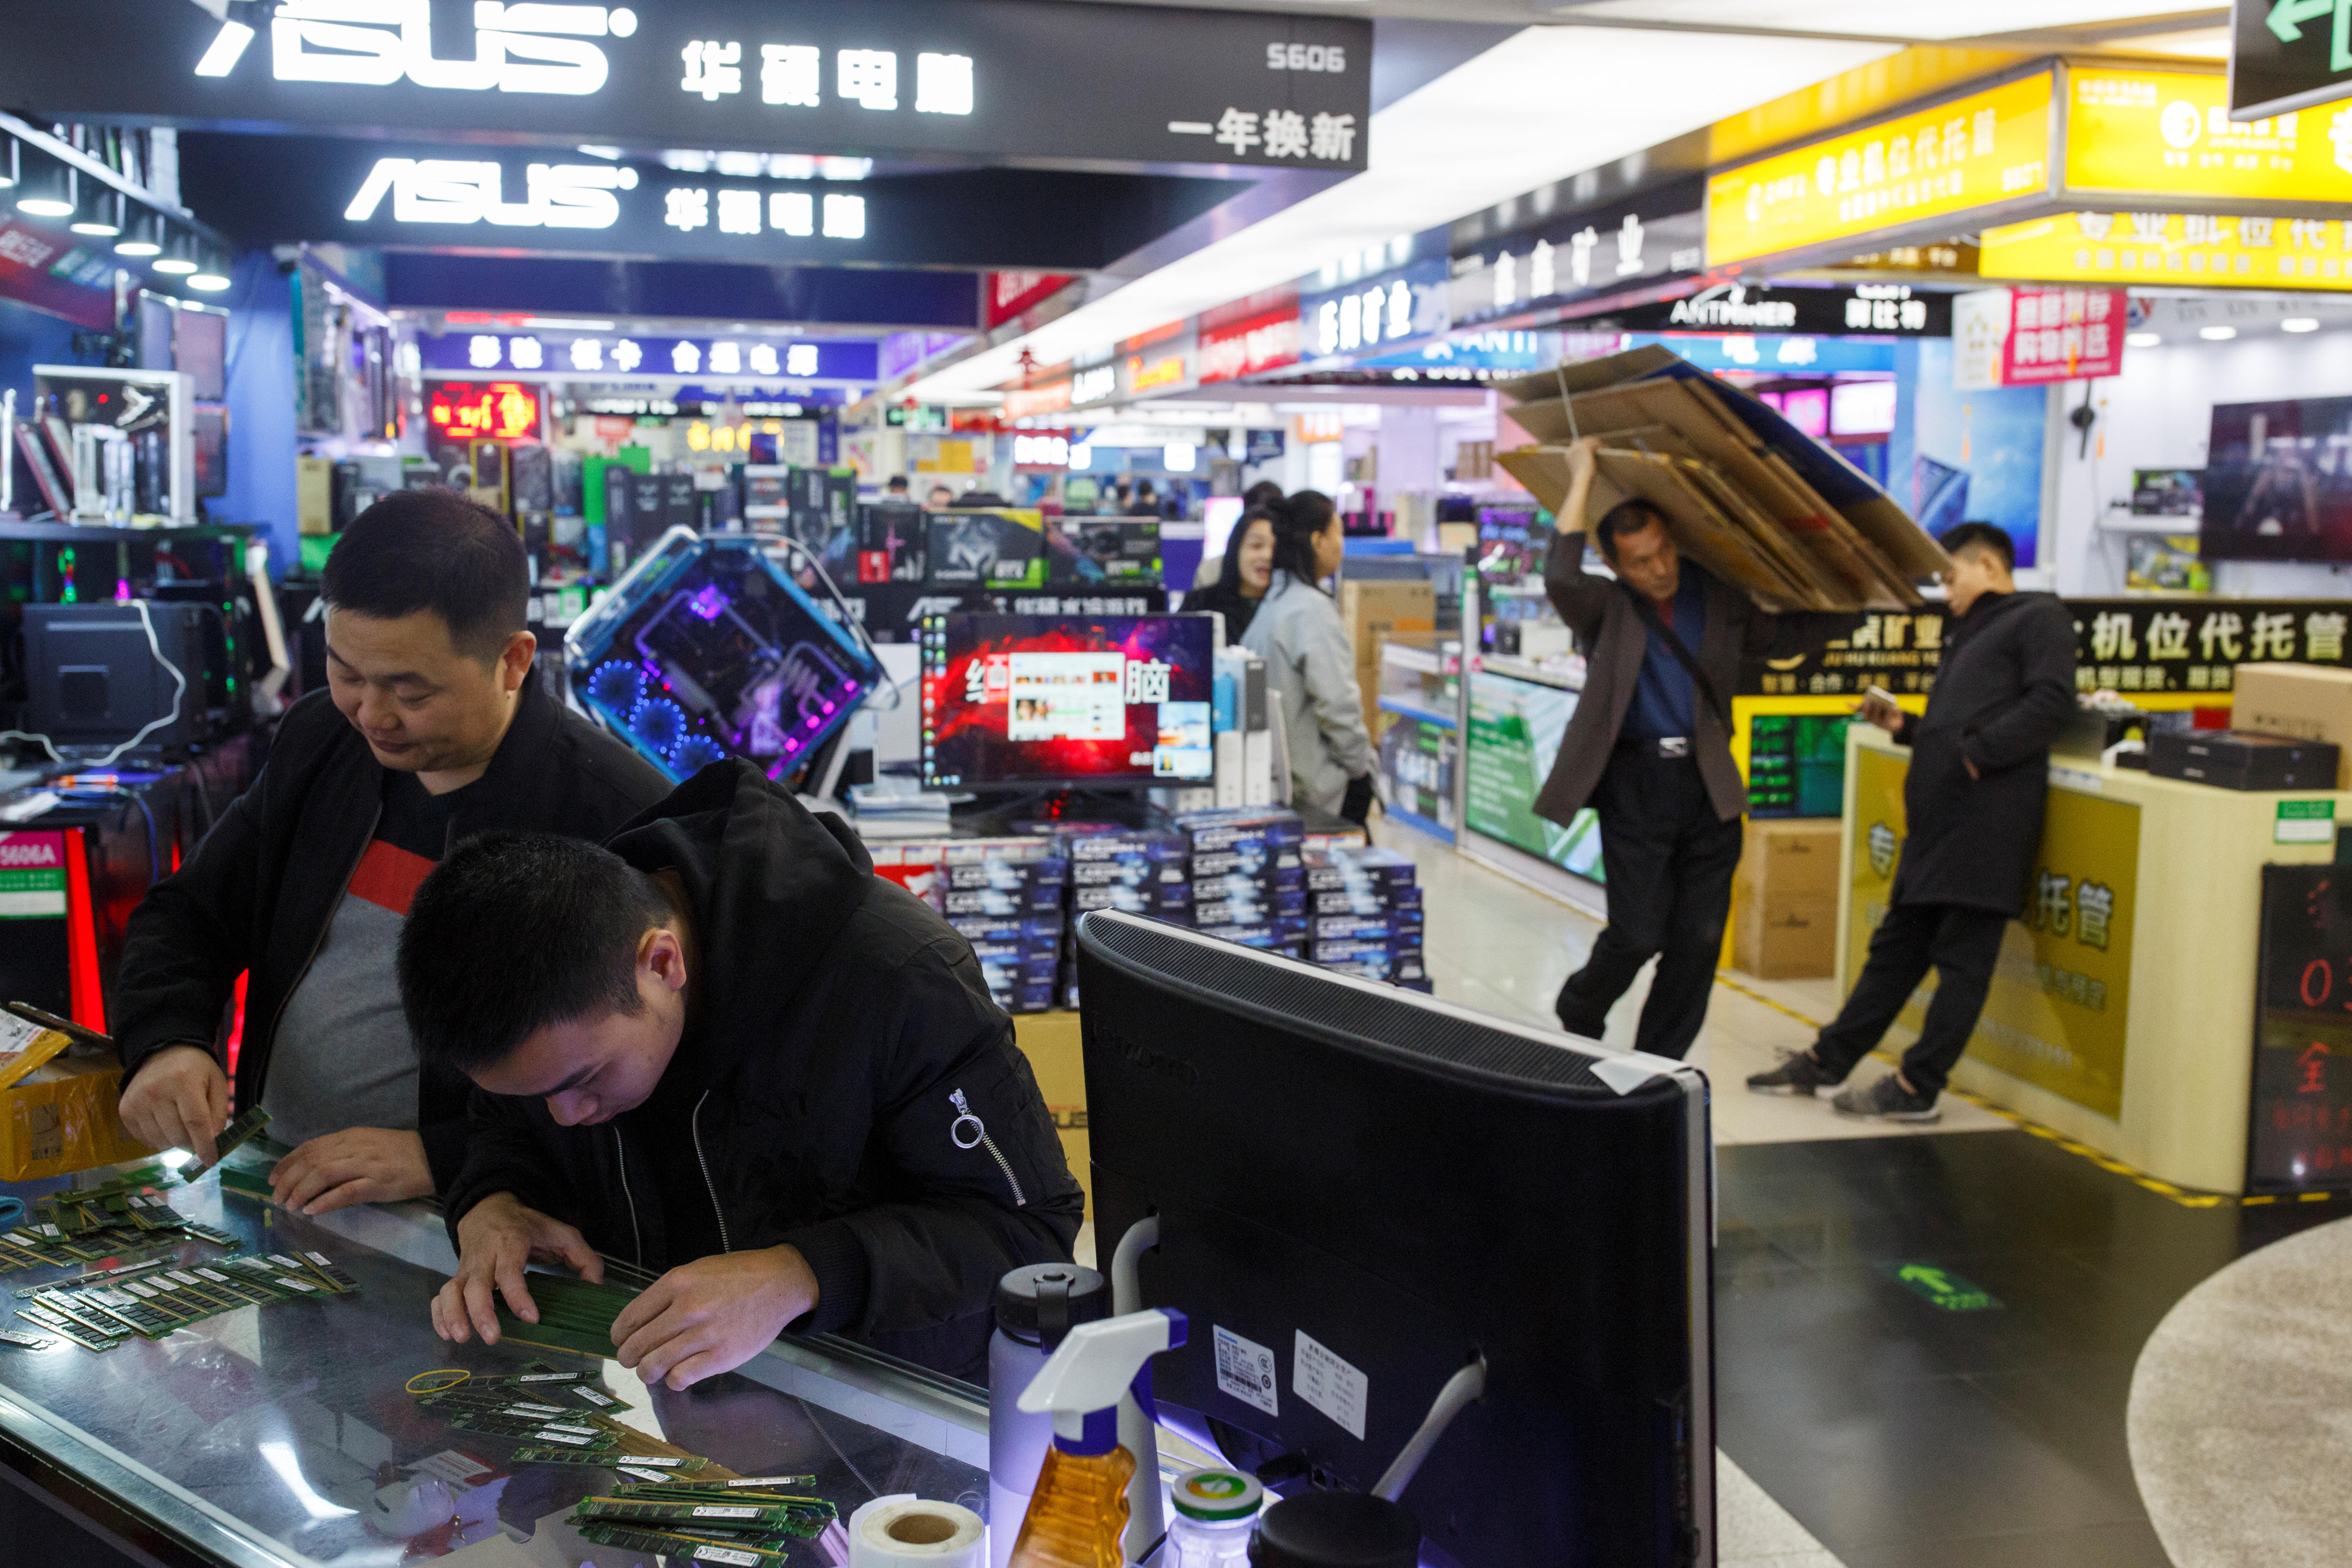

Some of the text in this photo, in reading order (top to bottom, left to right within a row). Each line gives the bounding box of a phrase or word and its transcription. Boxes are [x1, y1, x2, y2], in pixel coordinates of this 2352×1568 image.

[194, 0, 638, 95] ASUS
[1266, 42, 1346, 72] S606
[682, 40, 973, 115] 华硕电脑
[1168, 107, 1356, 161] 一年换新
[344, 158, 639, 229] ASUS
[665, 189, 866, 239] 华硕电脑
[2073, 612, 2347, 661] 机位代托管
[1125, 658, 1171, 706] 脑
[2036, 870, 2114, 951] 托管
